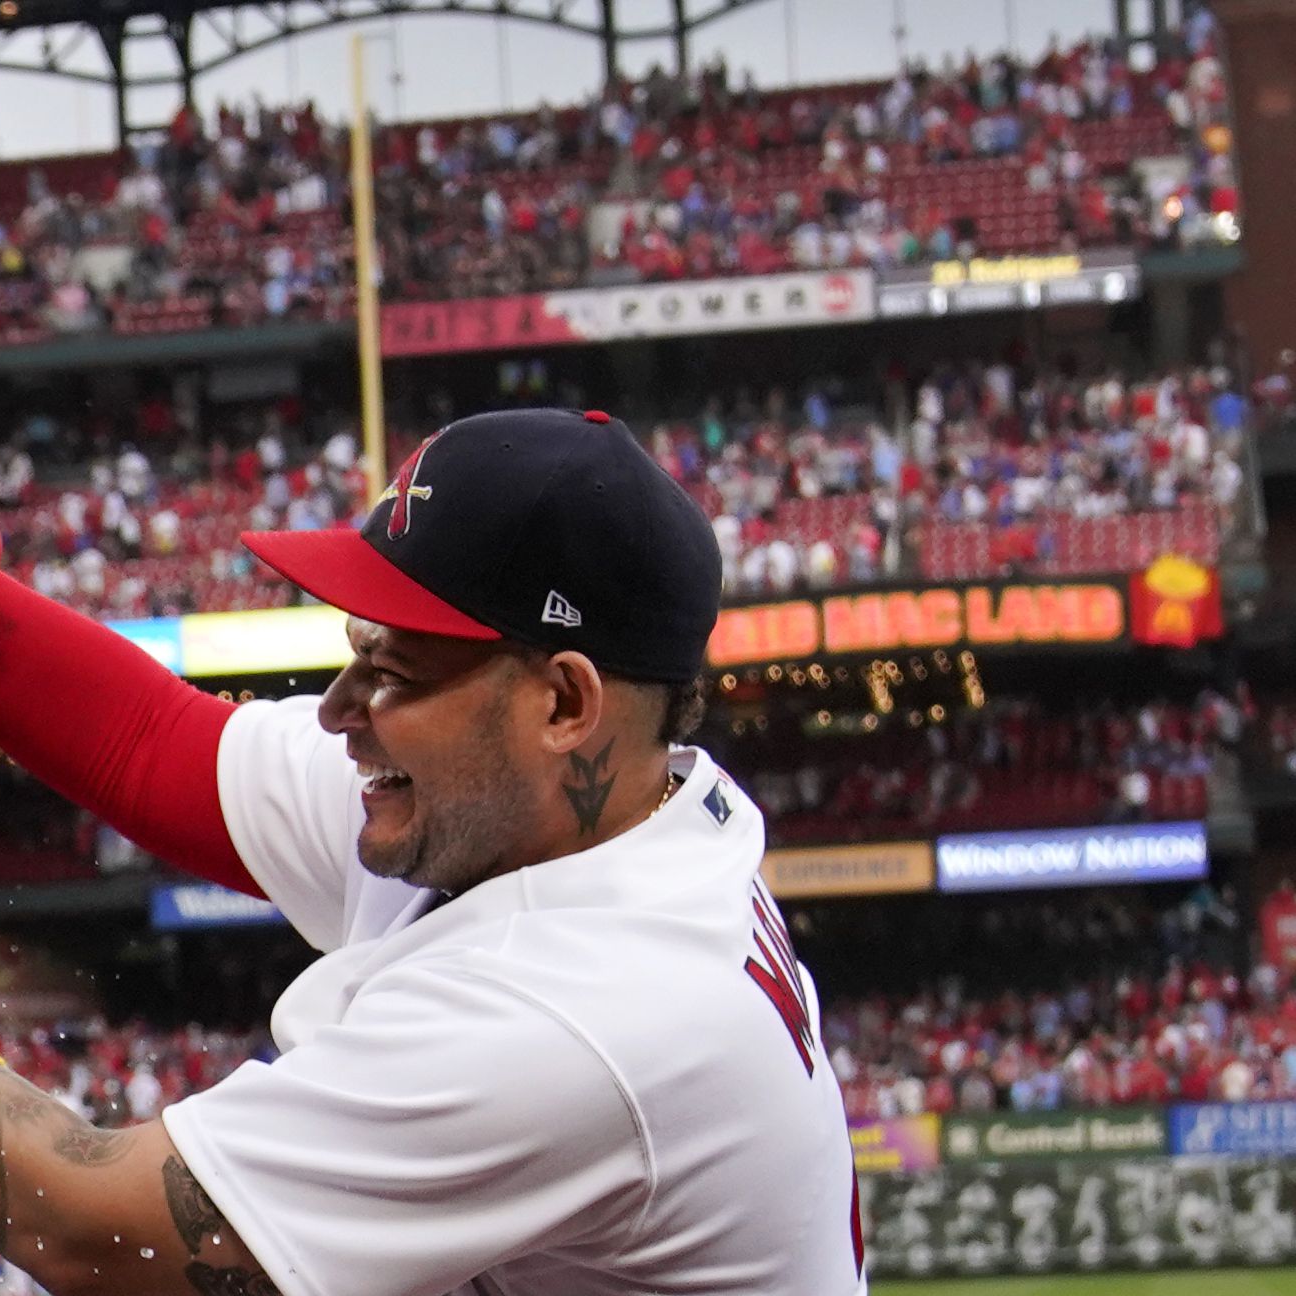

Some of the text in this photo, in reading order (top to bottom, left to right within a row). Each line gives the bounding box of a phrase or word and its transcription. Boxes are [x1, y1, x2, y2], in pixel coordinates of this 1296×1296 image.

[619, 286, 807, 322] POWER
[823, 588, 963, 654] MAC
[965, 583, 1125, 643] LAND
[939, 833, 1206, 878] WINDOW NATION
